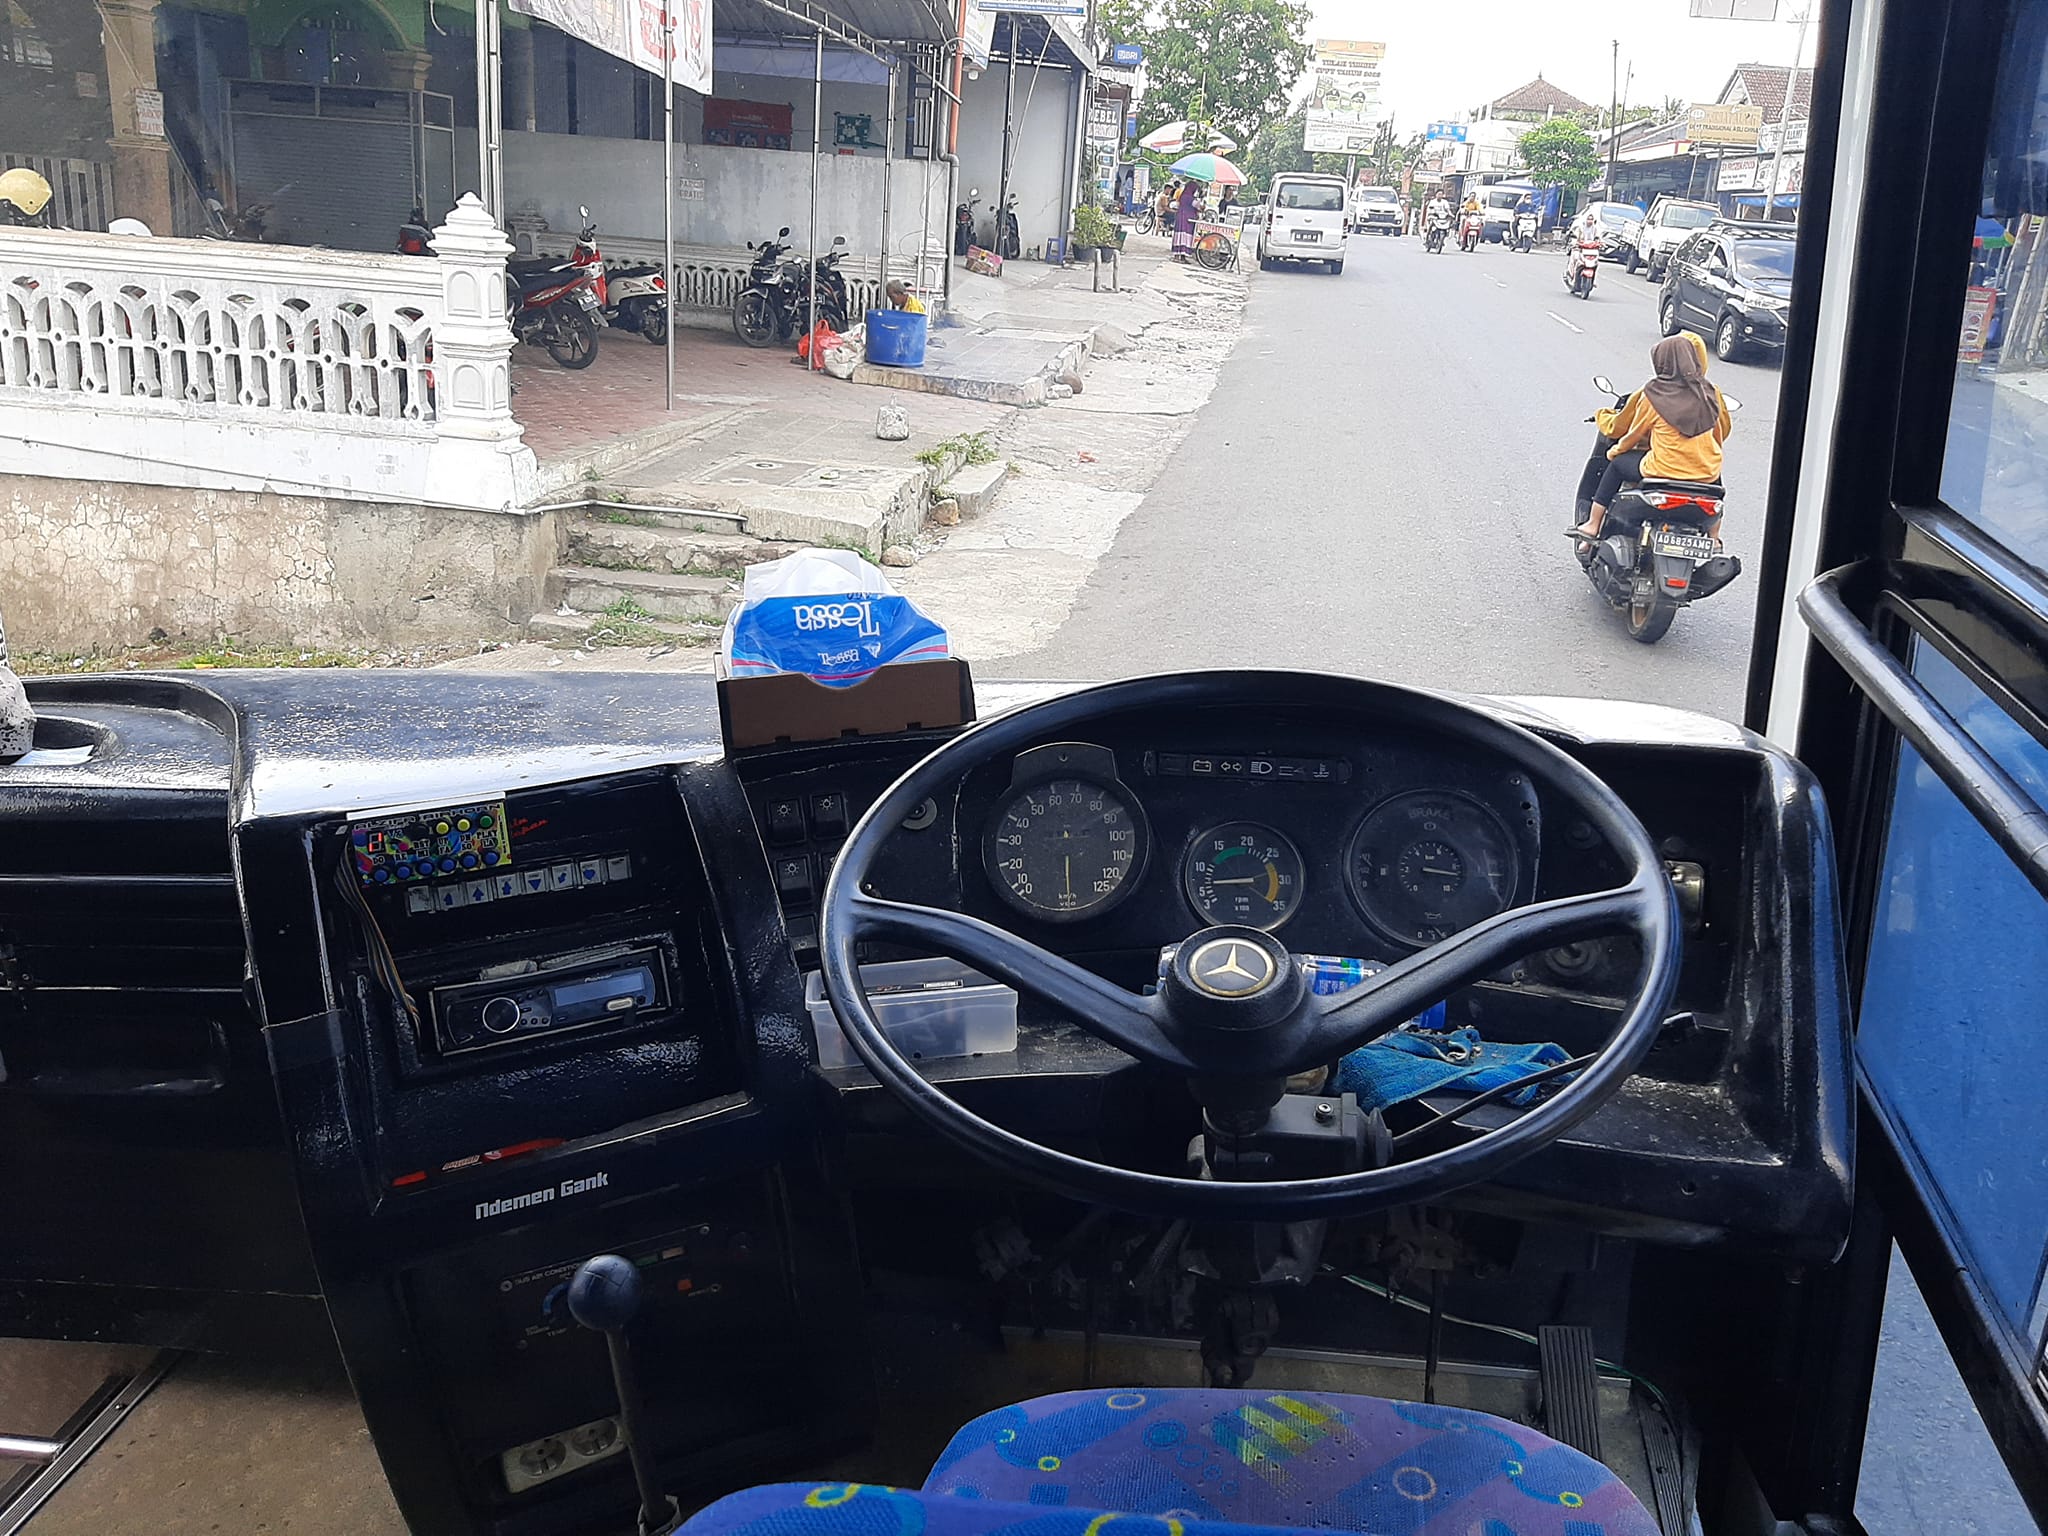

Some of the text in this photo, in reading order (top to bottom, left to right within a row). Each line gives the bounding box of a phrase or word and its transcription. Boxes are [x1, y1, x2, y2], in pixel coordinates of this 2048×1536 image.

[792, 601, 880, 638] Tessa
[817, 648, 860, 667] Tessa
[1048, 795, 1062, 806] 60
[1070, 793, 1082, 804] 70
[1031, 804, 1044, 815] 50
[1089, 800, 1103, 811] 80
[1016, 818, 1029, 828] 40
[1103, 813, 1117, 824] 90
[477, 829, 498, 839] PLAY
[1109, 830, 1125, 841] 100
[1008, 835, 1022, 846] 30
[1214, 840, 1224, 851] 15
[1240, 836, 1254, 846] 20
[1112, 850, 1126, 861] 110
[1266, 848, 1279, 858] 25
[372, 855, 386, 865] DO
[1009, 858, 1022, 869] 20
[1195, 862, 1205, 872] 10
[1017, 873, 1028, 884] 10
[1102, 867, 1119, 879] 120
[1278, 875, 1291, 885] 30
[1025, 883, 1033, 894] 0
[1093, 880, 1110, 892] 125
[1199, 887, 1205, 897] 5
[1204, 900, 1210, 910] 3
[1273, 901, 1286, 911] 35
[560, 1170, 610, 1198] Gank
